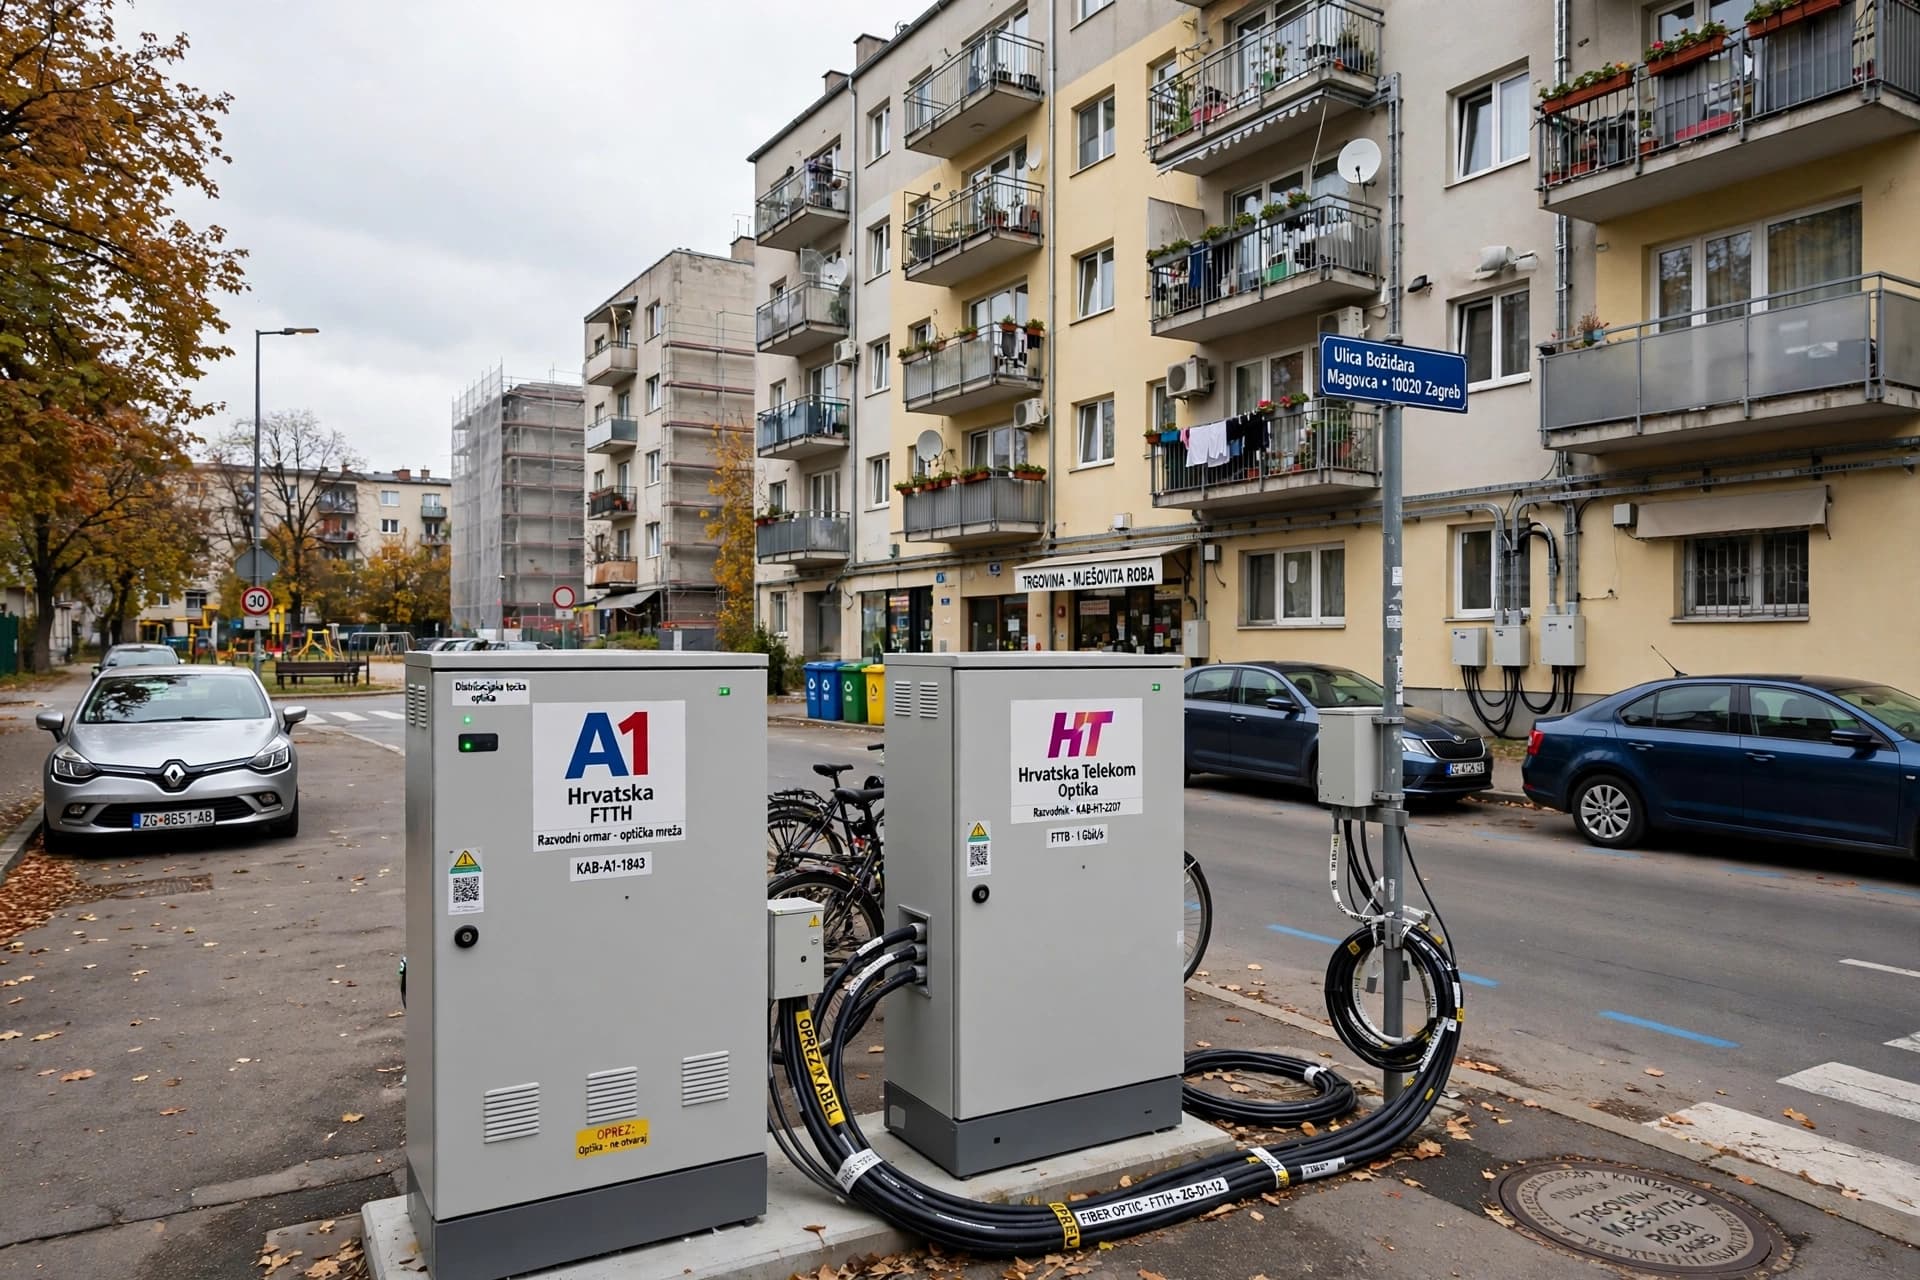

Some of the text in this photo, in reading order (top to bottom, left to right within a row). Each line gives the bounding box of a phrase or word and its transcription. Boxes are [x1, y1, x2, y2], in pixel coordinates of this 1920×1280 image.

[1334, 346, 1415, 373] Ulica Božidara
[1327, 368, 1378, 389] Magovca
[1391, 377, 1421, 395] 10020
[1425, 381, 1461, 402] Zagreb
[1023, 573, 1065, 589] TRGOVINA
[1073, 567, 1124, 586] MJEŠOVITA
[1127, 567, 1154, 583] ROBA
[248, 595, 265, 608] 30
[1047, 710, 1114, 758] HT
[565, 711, 649, 779] A1
[1018, 762, 1136, 783] Hrvatska Telekom
[568, 784, 654, 805] Hrvatska
[1058, 782, 1098, 800] Optika
[590, 805, 632, 823] FTTH
[1033, 805, 1069, 817] Razvodnik
[538, 831, 581, 846] Razvodni
[583, 833, 611, 843] ormar
[620, 827, 654, 843] optička
[656, 825, 682, 838] mreža
[1051, 831, 1070, 843] FTTB
[576, 857, 646, 875] KAB-A1-1843
[799, 1018, 820, 1067] OPREZ
[610, 1141, 620, 1149] ne
[1080, 1211, 1112, 1224] FIBER
[1112, 1201, 1143, 1217] OPTIC
[1149, 1193, 1175, 1209] FTTH
[1180, 1180, 1224, 1200] ZG-D1-12
